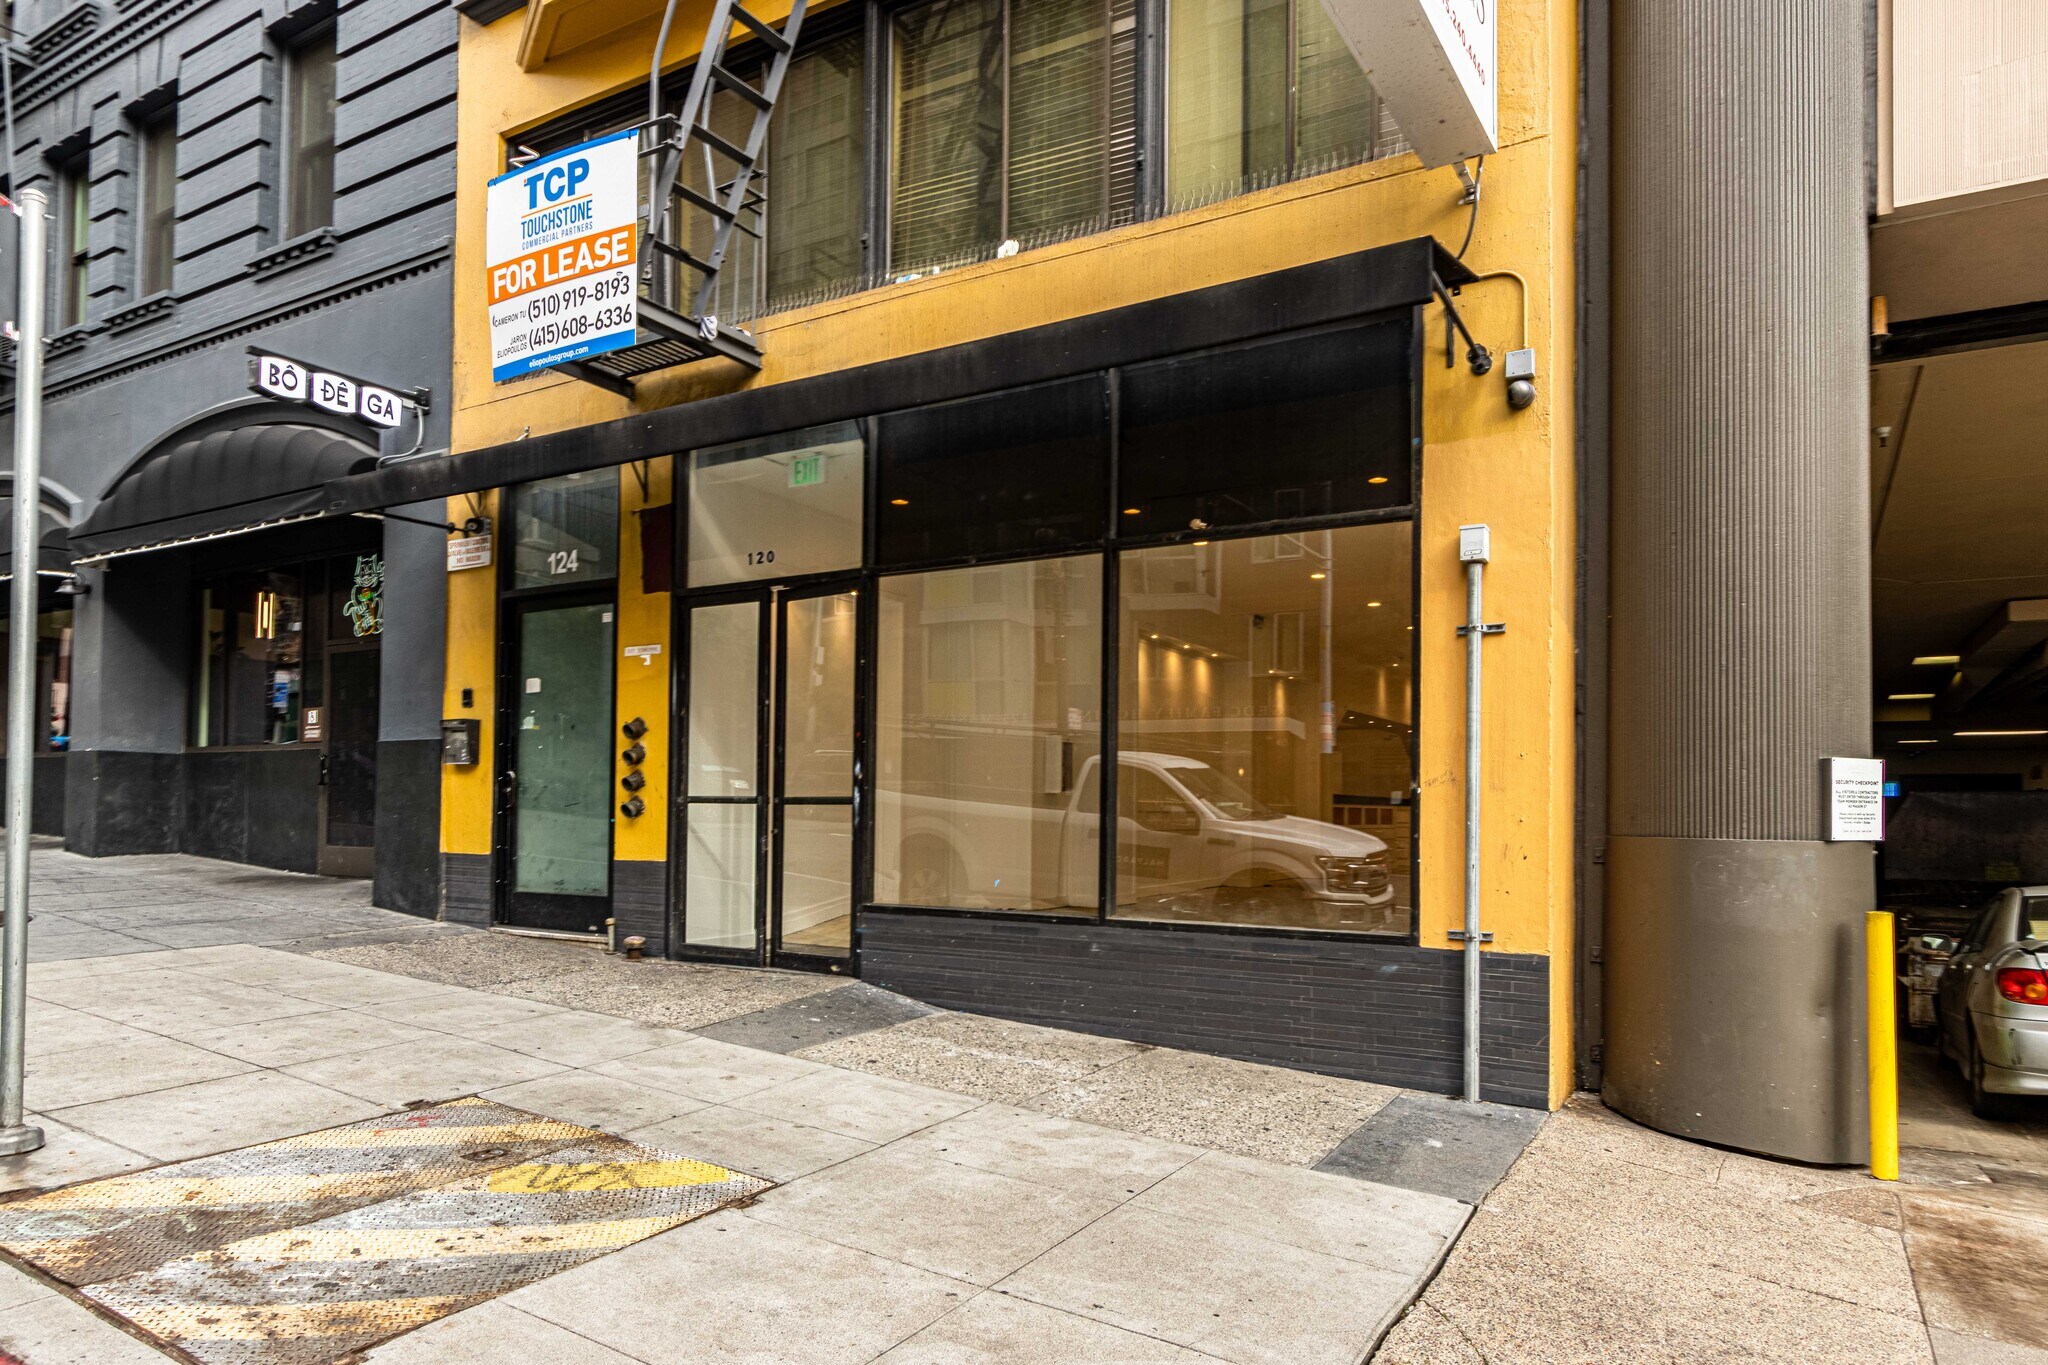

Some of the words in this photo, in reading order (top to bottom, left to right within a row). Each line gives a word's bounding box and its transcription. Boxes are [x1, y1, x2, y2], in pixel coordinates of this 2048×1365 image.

[524, 158, 590, 210] TCP
[521, 199, 593, 240] TOUCHSTONE
[522, 231, 559, 251] COMMERCIAL
[561, 221, 593, 239] PARTNERS
[493, 258, 537, 299] FOR
[543, 231, 629, 282] LEASE
[494, 312, 519, 328] CAMERON
[519, 309, 527, 319] TU
[528, 294, 561, 325] (510)
[563, 275, 630, 311] 919-8193
[497, 342, 528, 359] ELIOPOULOS
[529, 321, 561, 352] (415)
[561, 303, 632, 339] 608-6336
[510, 333, 527, 346] JARON
[529, 345, 589, 368] eliopoulosgroup.com
[269, 363, 298, 391] BÔ
[367, 393, 394, 420] GA
[793, 456, 820, 486] EXIT
[547, 549, 579, 575] 124
[747, 550, 775, 565] 120
